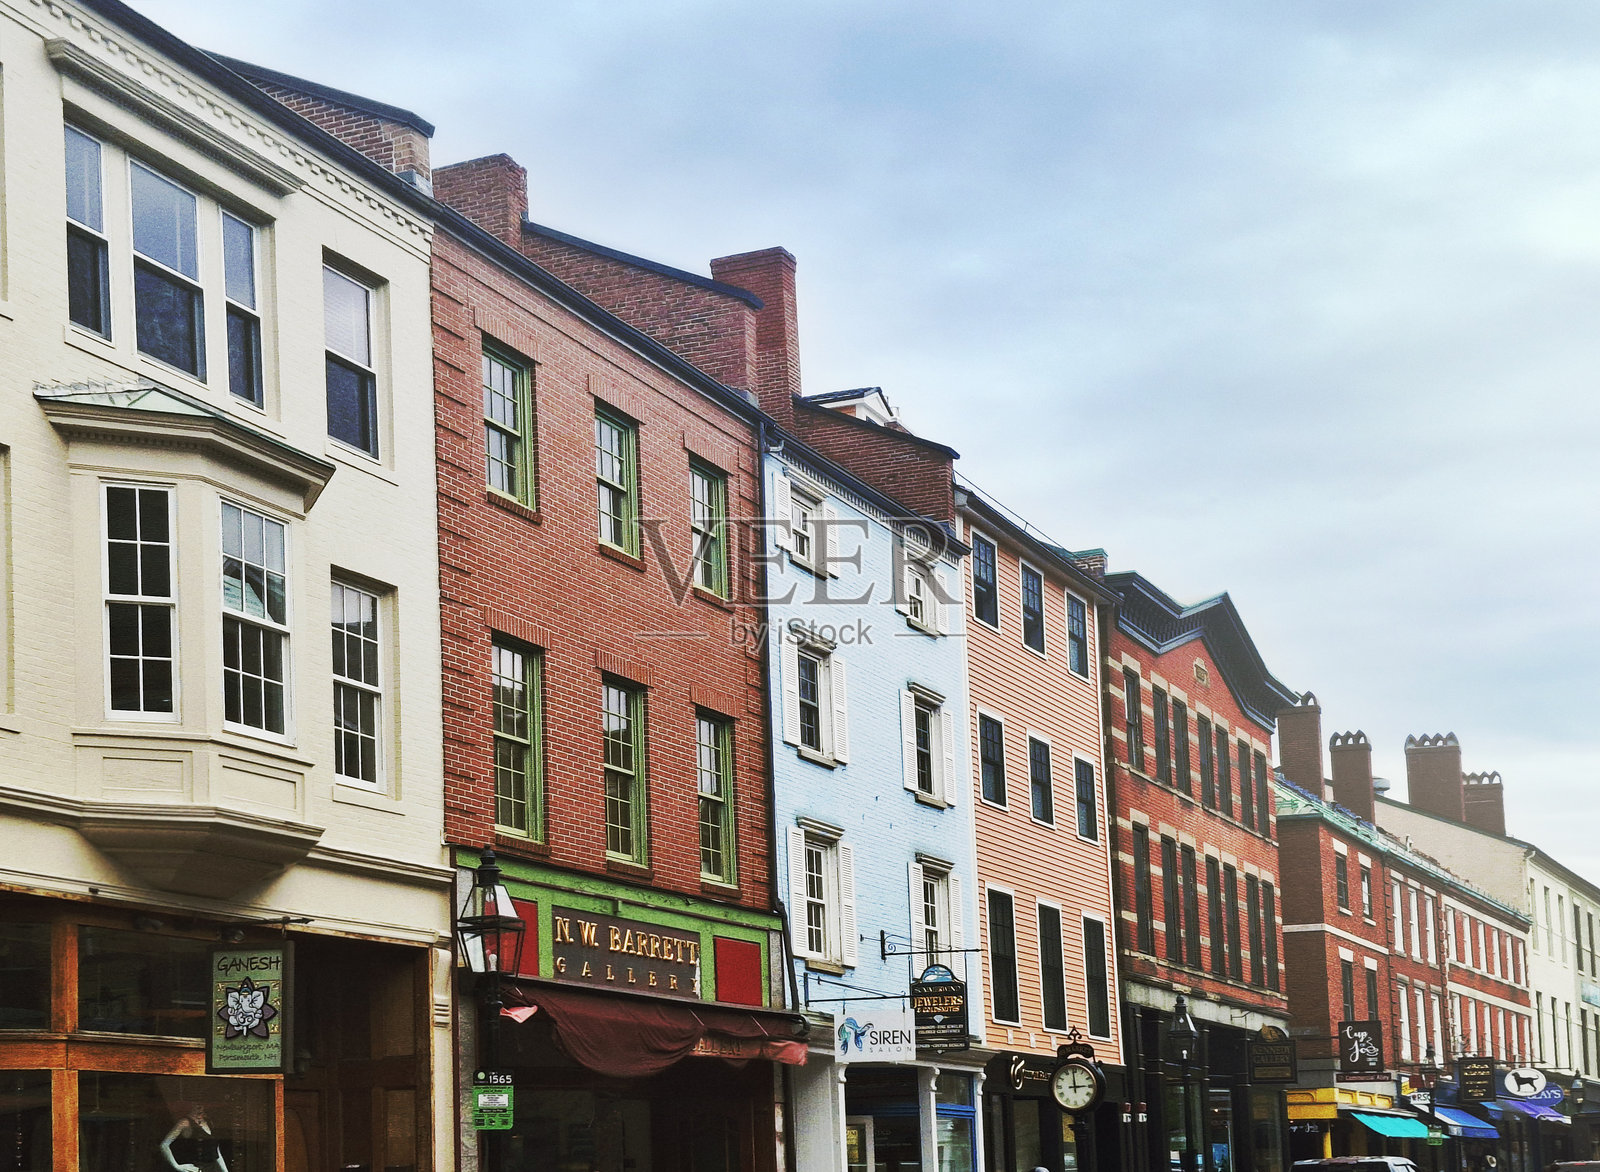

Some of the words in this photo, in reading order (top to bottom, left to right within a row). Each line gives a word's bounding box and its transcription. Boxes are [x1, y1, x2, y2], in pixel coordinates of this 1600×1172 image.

[555, 916, 574, 943] N.
[577, 919, 599, 947] W.
[608, 925, 699, 965] BARRETT
[217, 956, 281, 976] GANESH
[913, 995, 964, 1009] JEWELERS
[869, 1030, 912, 1046] SIREN
[1342, 1025, 1368, 1042] Cup
[489, 1074, 513, 1084] 1565
